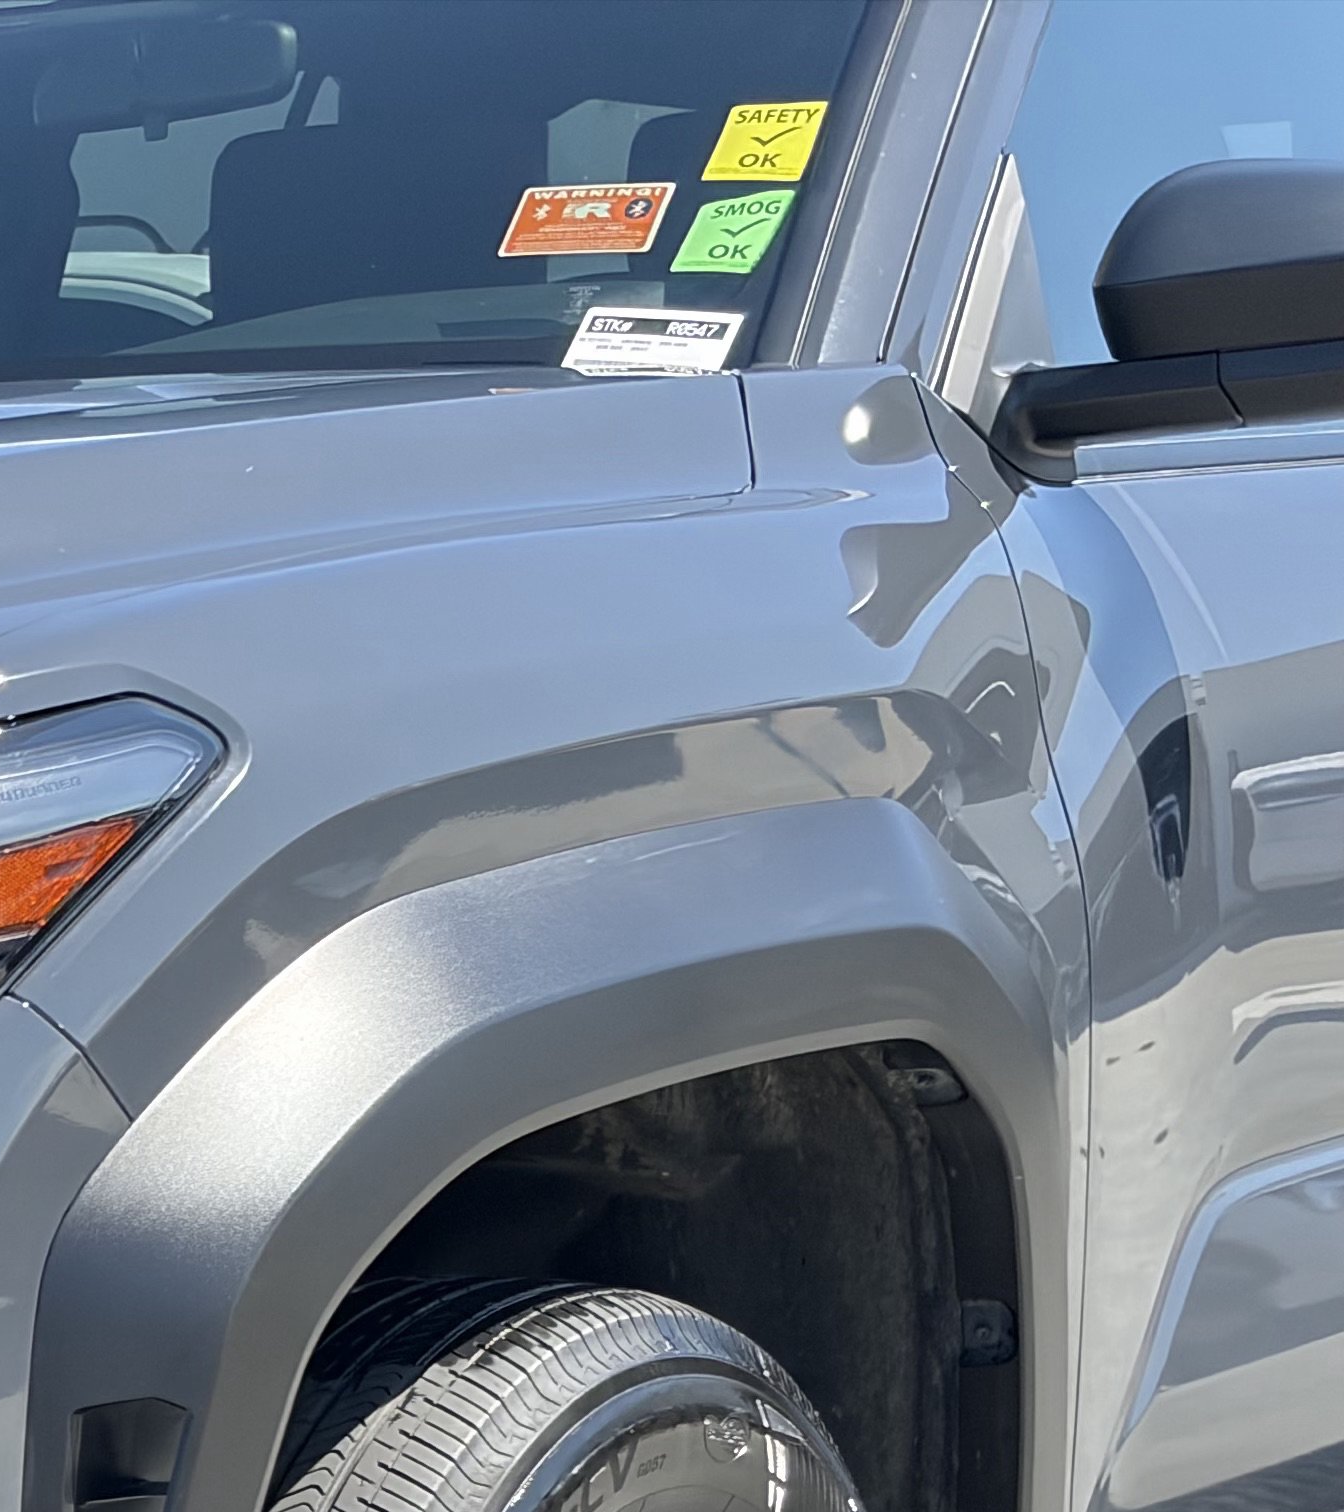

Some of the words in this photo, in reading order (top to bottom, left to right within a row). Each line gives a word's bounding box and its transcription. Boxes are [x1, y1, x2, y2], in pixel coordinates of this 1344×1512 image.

[734, 108, 820, 124] SAFETY
[738, 153, 782, 168] OK
[534, 187, 662, 200] WARNING!
[710, 200, 782, 219] SMOG
[707, 244, 752, 259] OK
